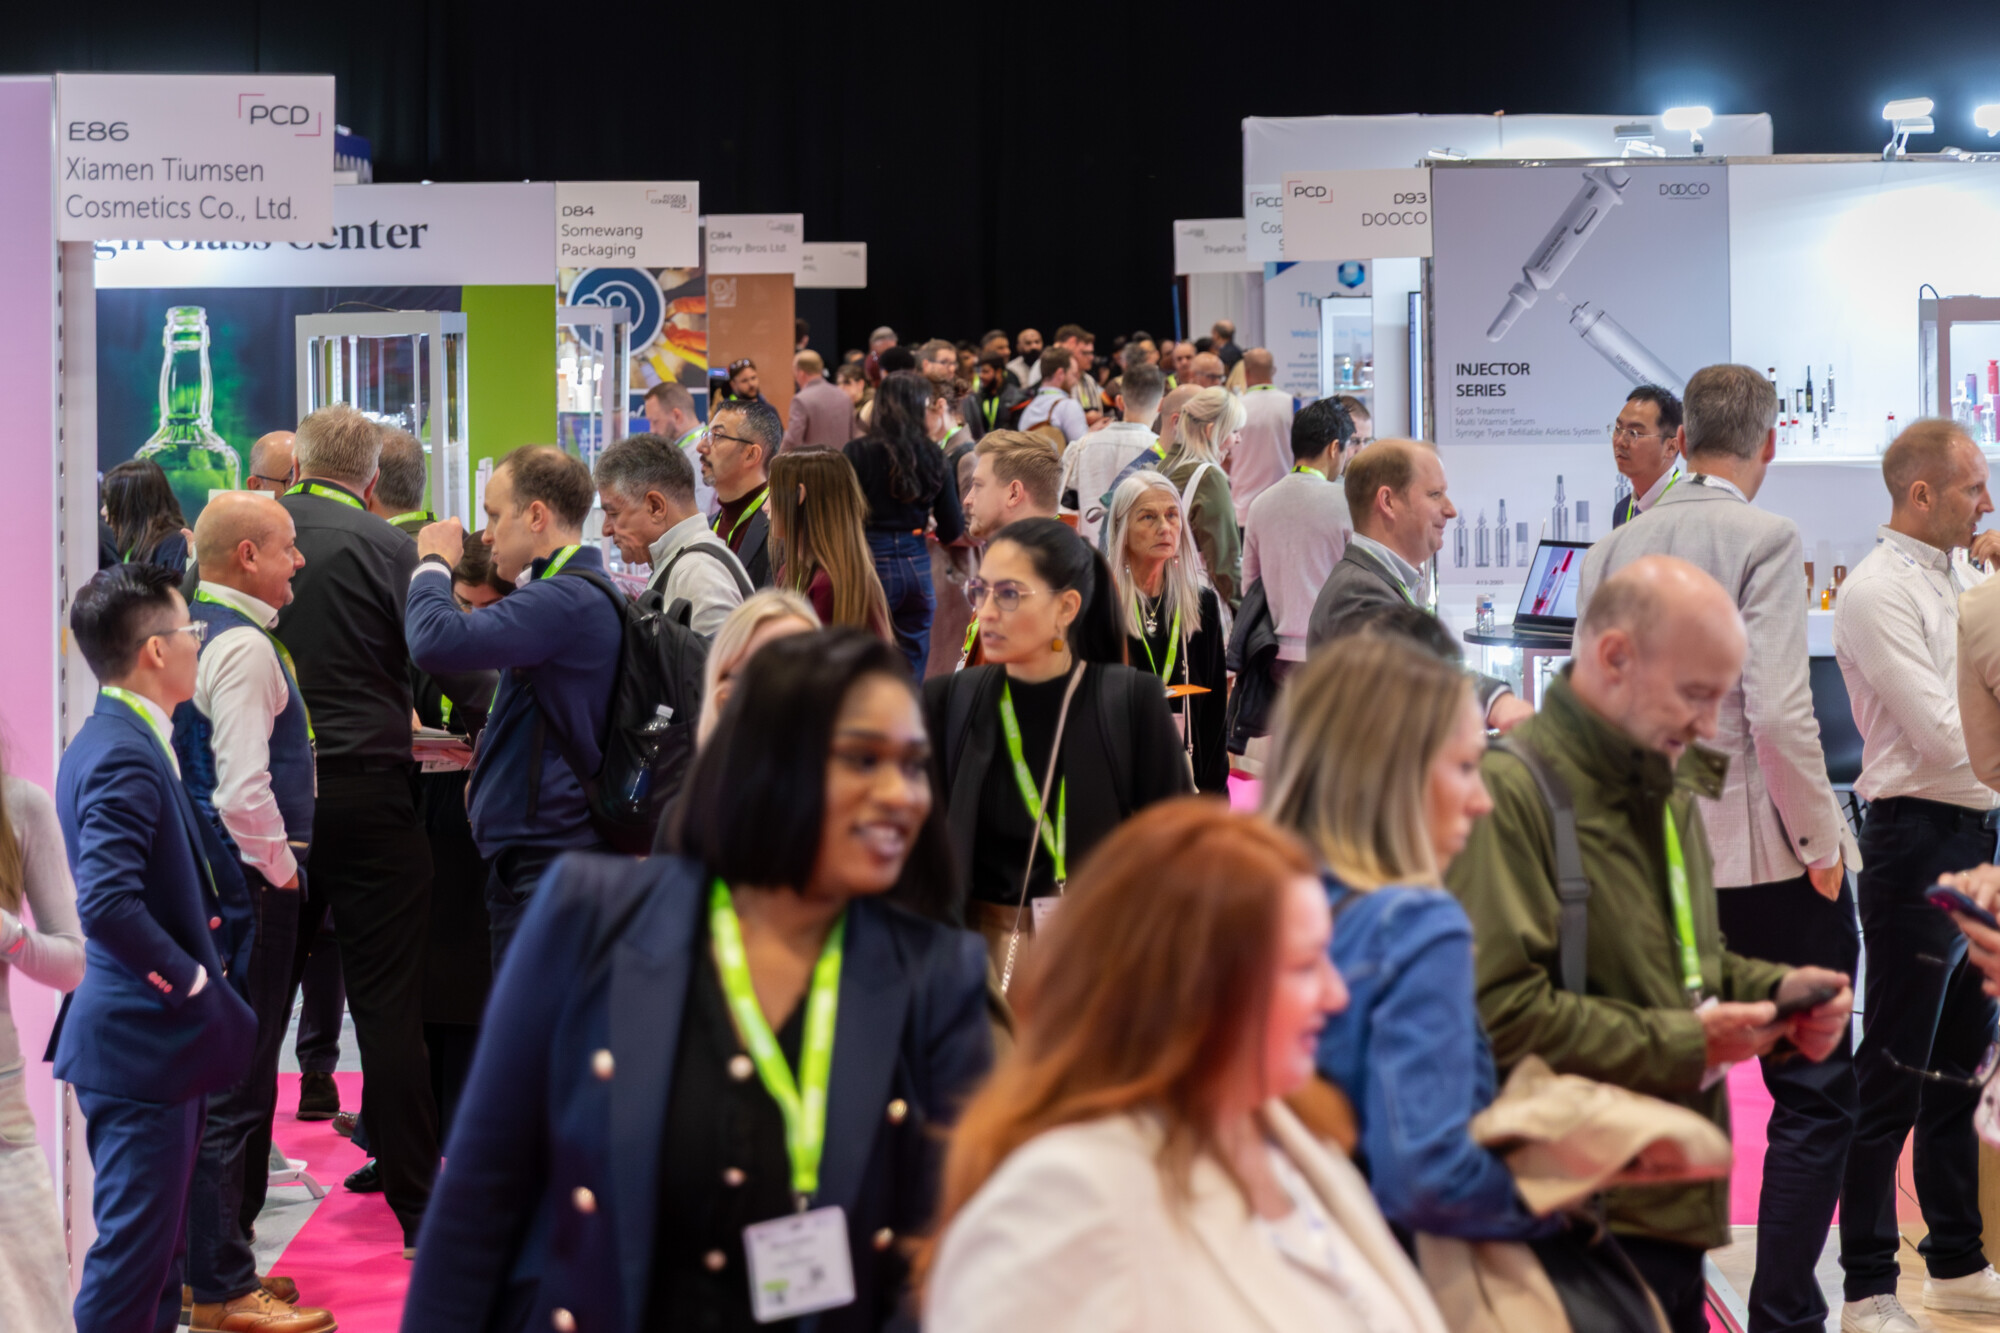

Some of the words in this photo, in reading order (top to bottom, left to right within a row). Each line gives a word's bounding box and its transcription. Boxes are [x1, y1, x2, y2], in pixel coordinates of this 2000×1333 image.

[250, 105, 310, 125] PCD
[69, 122, 129, 142] E86
[66, 156, 154, 182] Xiamen
[162, 157, 264, 182] Tiumsen
[1294, 186, 1327, 198] PCD
[1659, 183, 1710, 196] DOOCO
[1394, 192, 1427, 204] D93
[66, 194, 191, 219] Cosmetics
[199, 195, 246, 222] Co.,
[255, 196, 298, 220] Ltd.
[562, 205, 596, 217] D84
[1362, 211, 1428, 226] DOOCO
[287, 219, 429, 250] nter
[561, 223, 643, 240] Somewang
[562, 243, 636, 259] Packaging
[710, 244, 742, 255] Denny
[1456, 362, 1530, 376] INJECTOR
[1456, 384, 1507, 397] SERIES
[1455, 407, 1474, 416] Spot
[1476, 407, 1516, 415] Treatment
[1455, 418, 1476, 426] Multi
[1478, 418, 1508, 426] Vitamin
[1455, 428, 1484, 438] Syringe
[1487, 428, 1505, 438] Type
[1573, 428, 1602, 438] System
